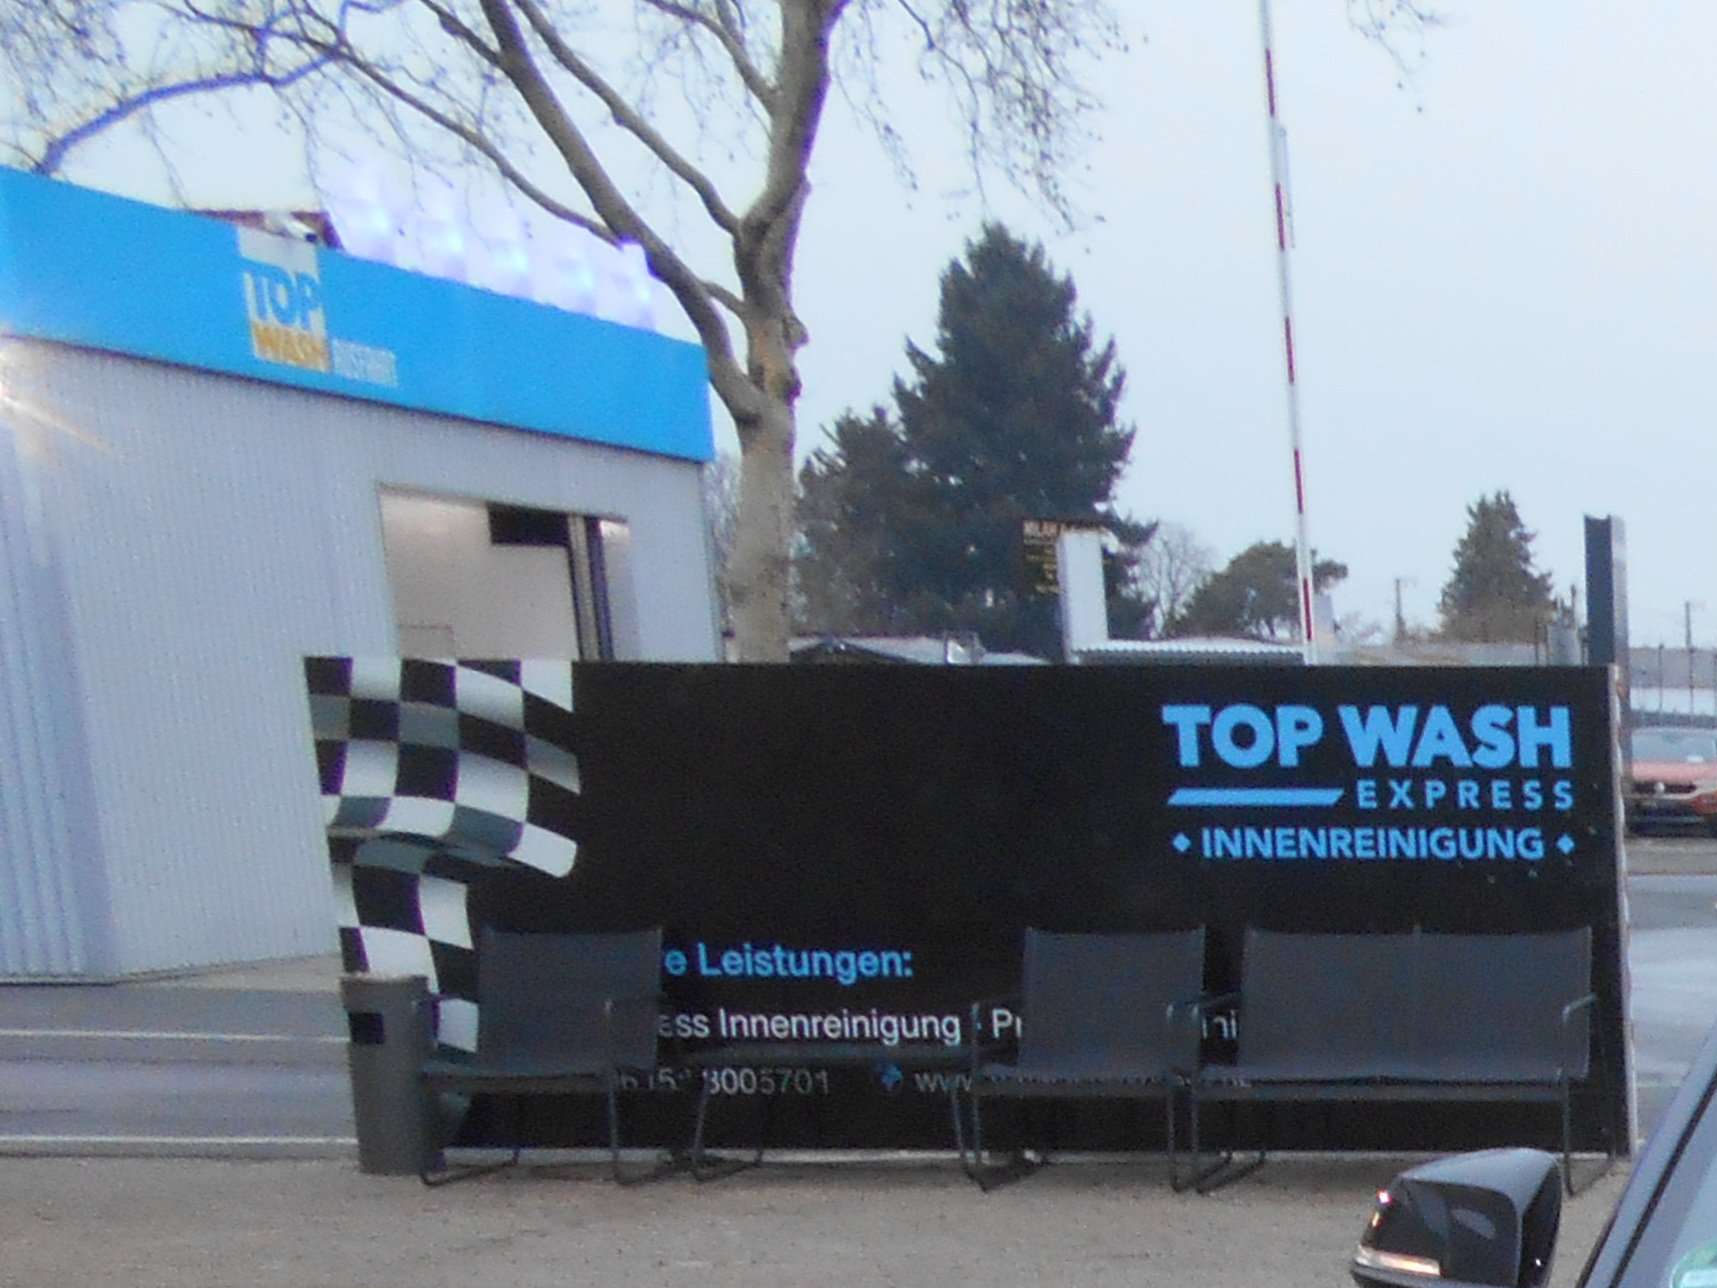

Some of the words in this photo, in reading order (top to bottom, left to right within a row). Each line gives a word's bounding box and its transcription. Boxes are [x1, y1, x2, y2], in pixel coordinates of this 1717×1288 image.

[241, 259, 322, 331] TOP
[1161, 704, 1324, 769] TOP
[1337, 704, 1573, 769] WASH
[1356, 780, 1575, 810] EXPRESS
[1202, 827, 1545, 860] INNENREINIGUNG
[698, 942, 913, 986] Leistungen:
[719, 1007, 961, 1047] Innenreinigung
